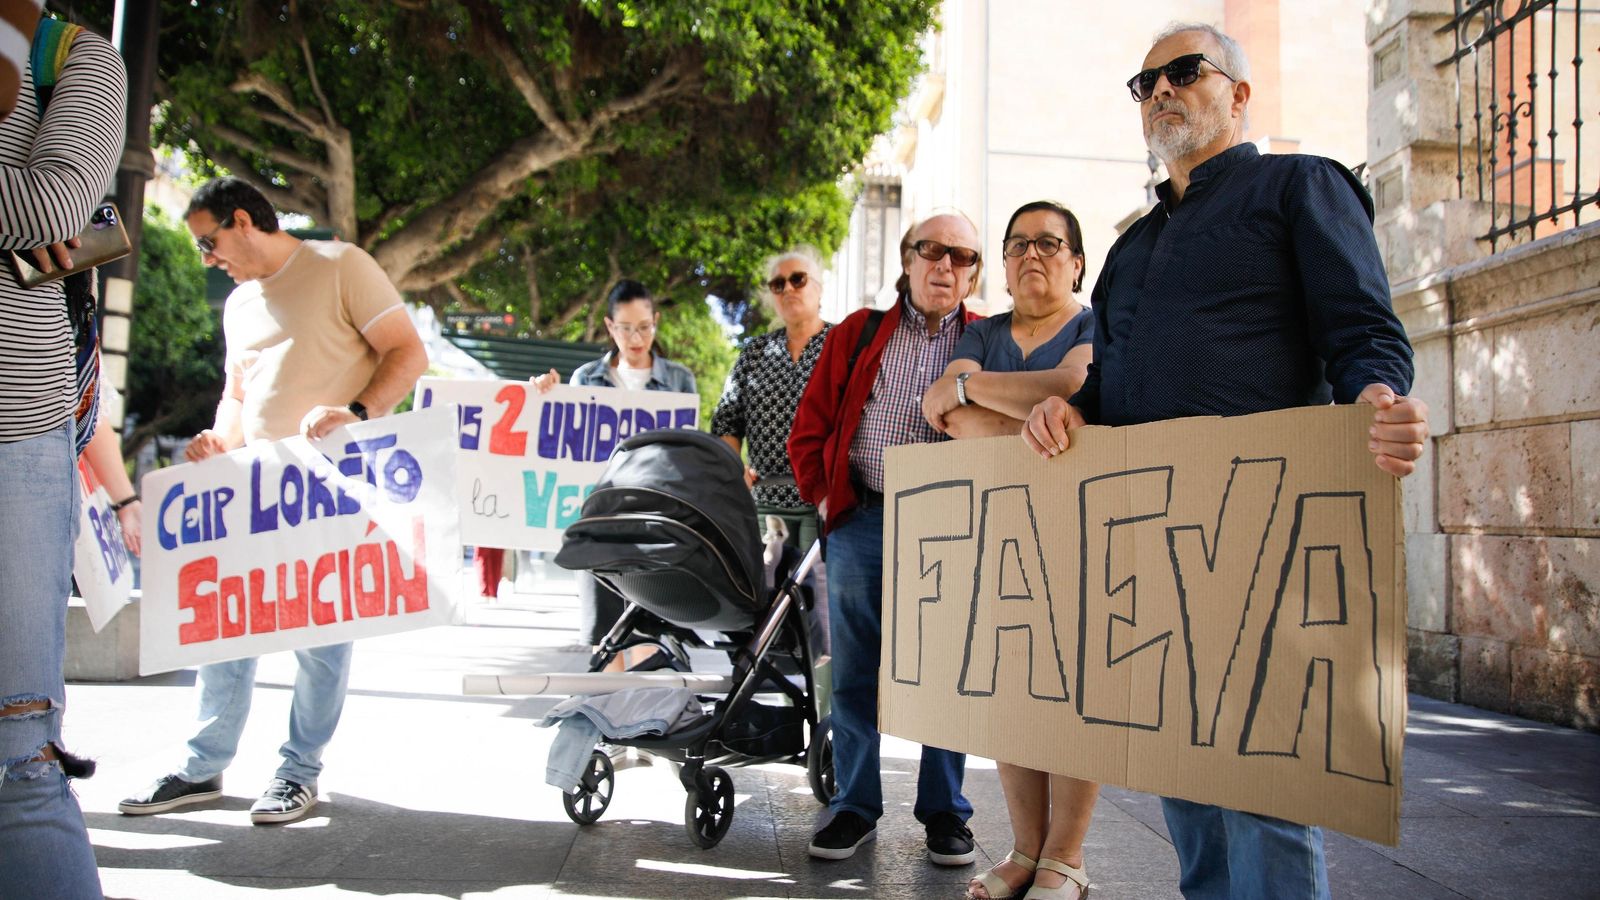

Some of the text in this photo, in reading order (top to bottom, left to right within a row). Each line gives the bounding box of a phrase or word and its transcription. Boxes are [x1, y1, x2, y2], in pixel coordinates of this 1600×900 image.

[489, 384, 529, 457] 2
[157, 481, 235, 551] CEIP
[250, 433, 423, 535] LORETO
[471, 470, 598, 530] la VE
[178, 515, 430, 646] SOLUCIÓN
[891, 456, 1394, 786] FAEVA
